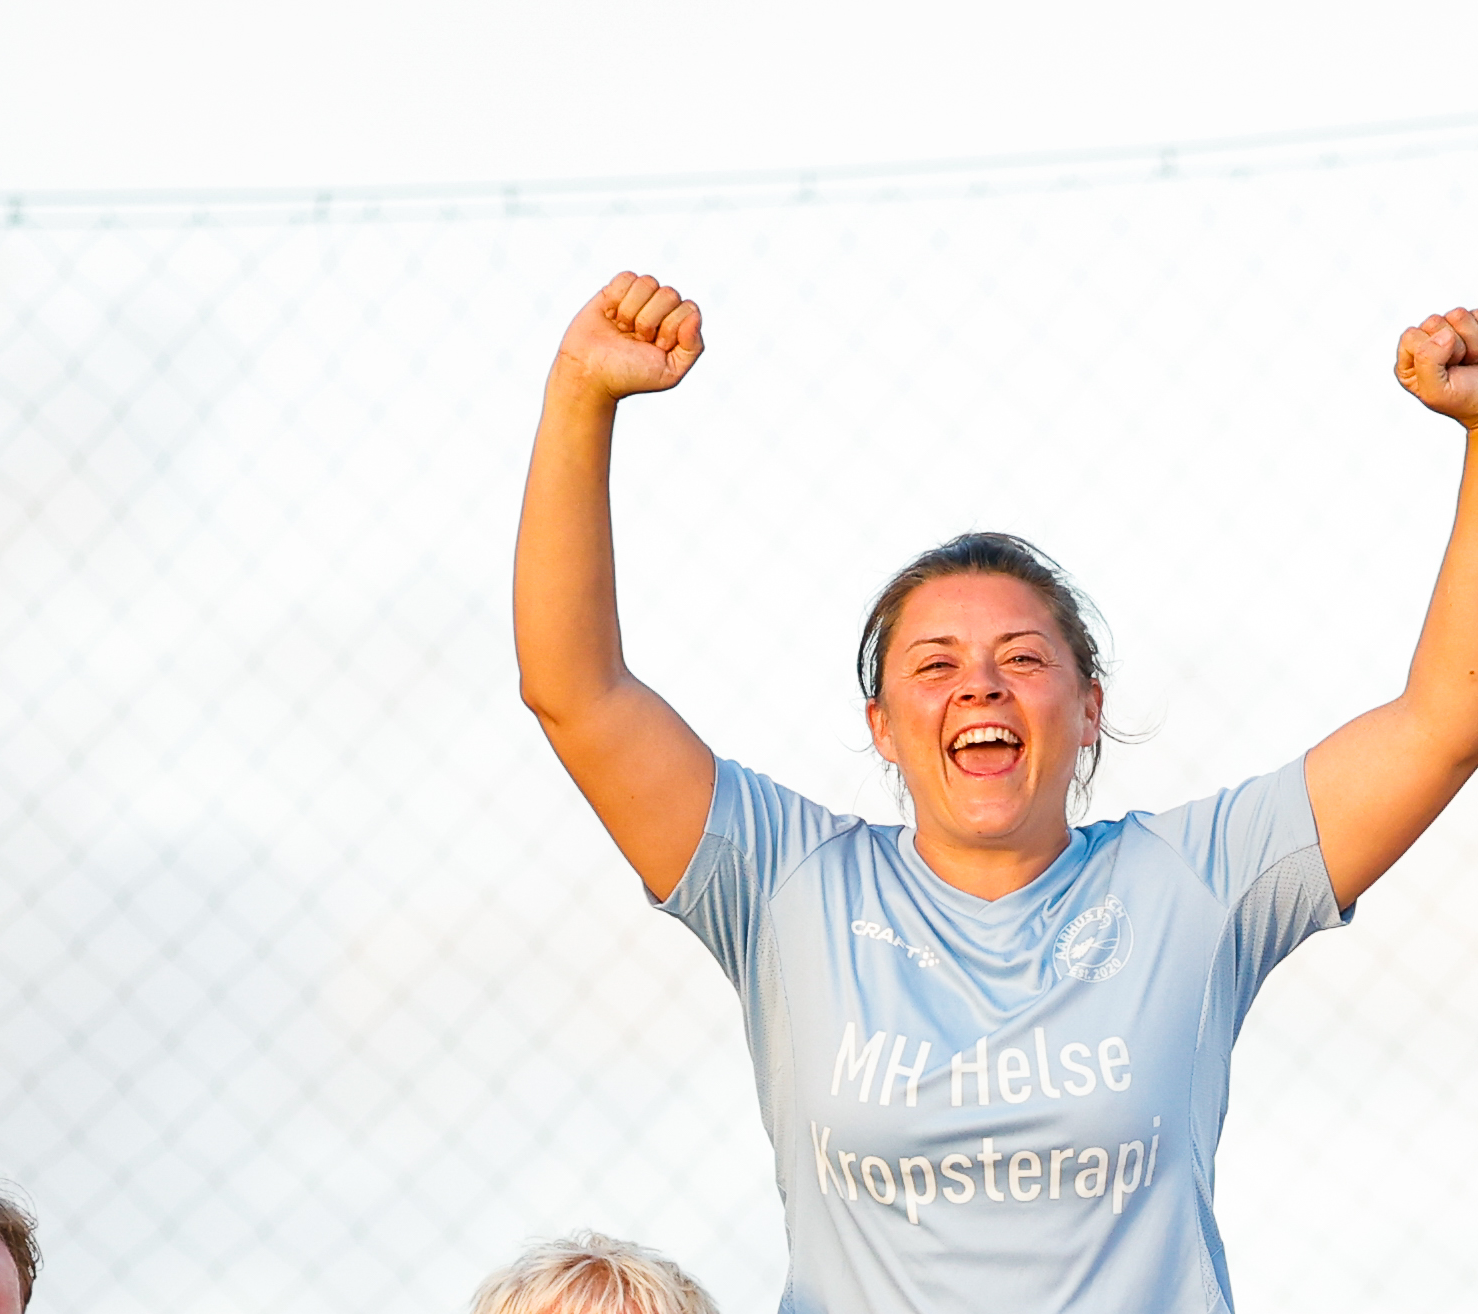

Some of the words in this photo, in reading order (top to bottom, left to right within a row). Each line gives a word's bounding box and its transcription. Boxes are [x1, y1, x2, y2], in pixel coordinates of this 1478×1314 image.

[850, 919, 922, 959] CRAFT
[1054, 911, 1099, 960] AARHUS
[1093, 957, 1122, 981] 2020
[830, 1020, 933, 1107] MH
[950, 1026, 1133, 1107] Helse
[809, 1115, 1163, 1225] Kropsterapi
